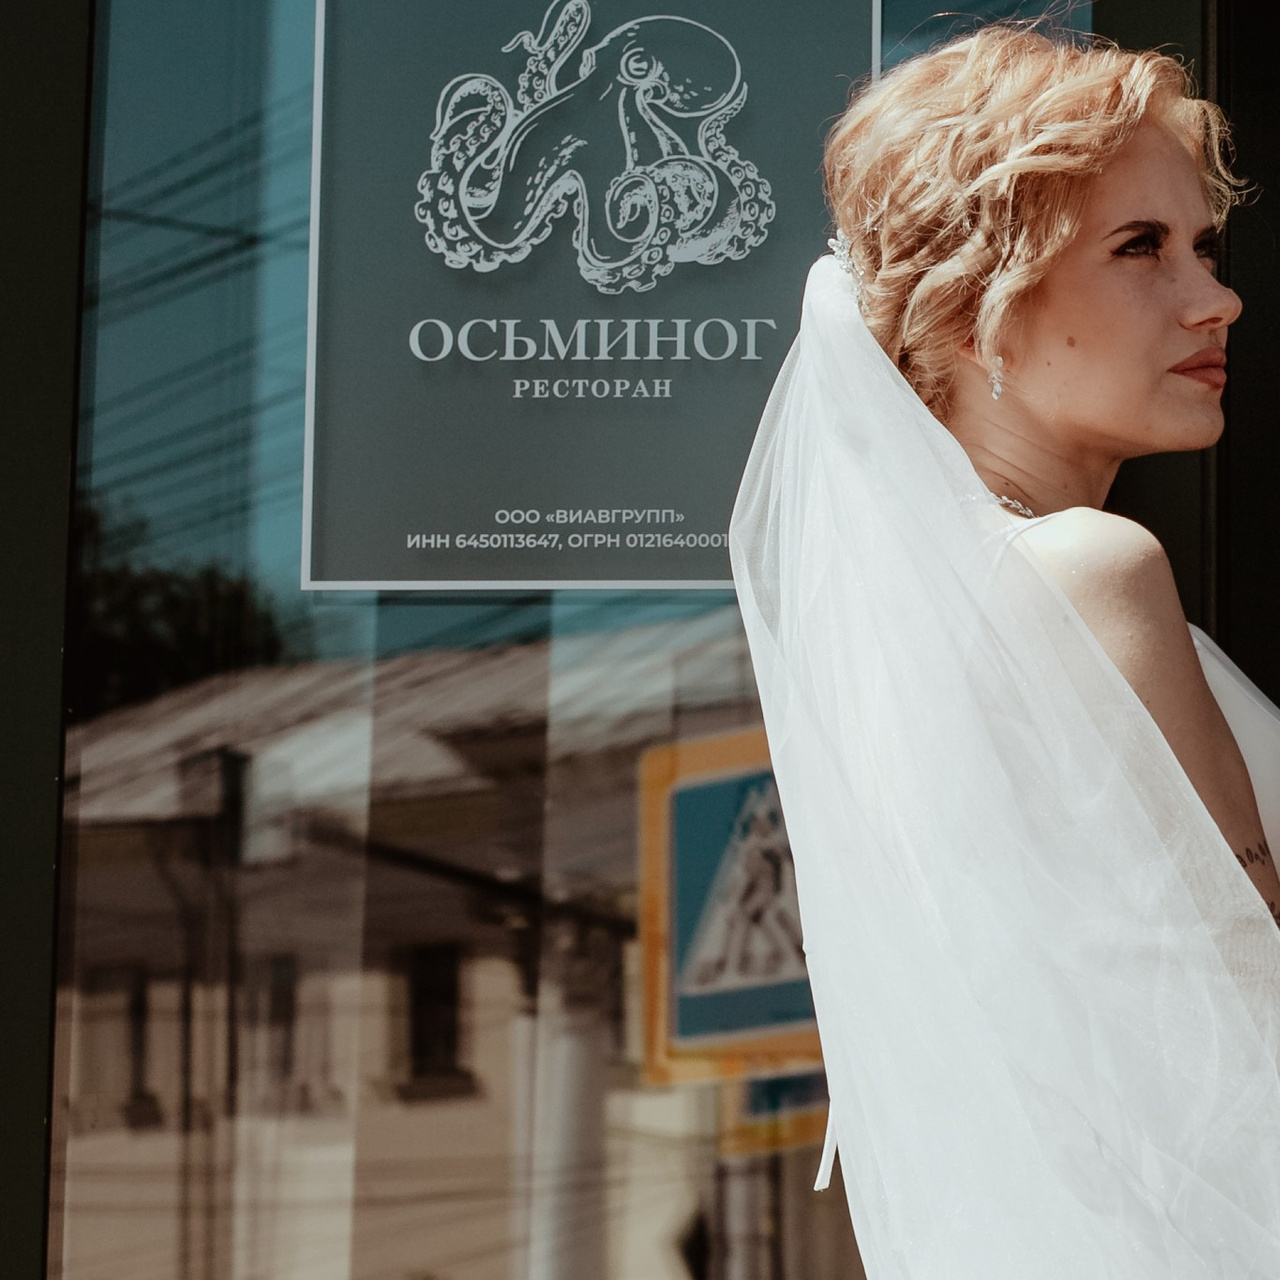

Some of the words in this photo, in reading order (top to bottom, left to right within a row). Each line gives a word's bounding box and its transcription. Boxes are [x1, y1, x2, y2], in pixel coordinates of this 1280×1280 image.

[408, 318, 778, 362] ОСЬМИНОГ
[512, 378, 673, 399] РЕСТОРАН
[494, 509, 541, 524] ООО
[545, 509, 685, 524] «ВИАВГРУПП»
[406, 533, 450, 549] ИНН
[455, 533, 563, 551] 6450113647,
[567, 533, 621, 548] ОГРН
[625, 533, 729, 548] 0121640001
